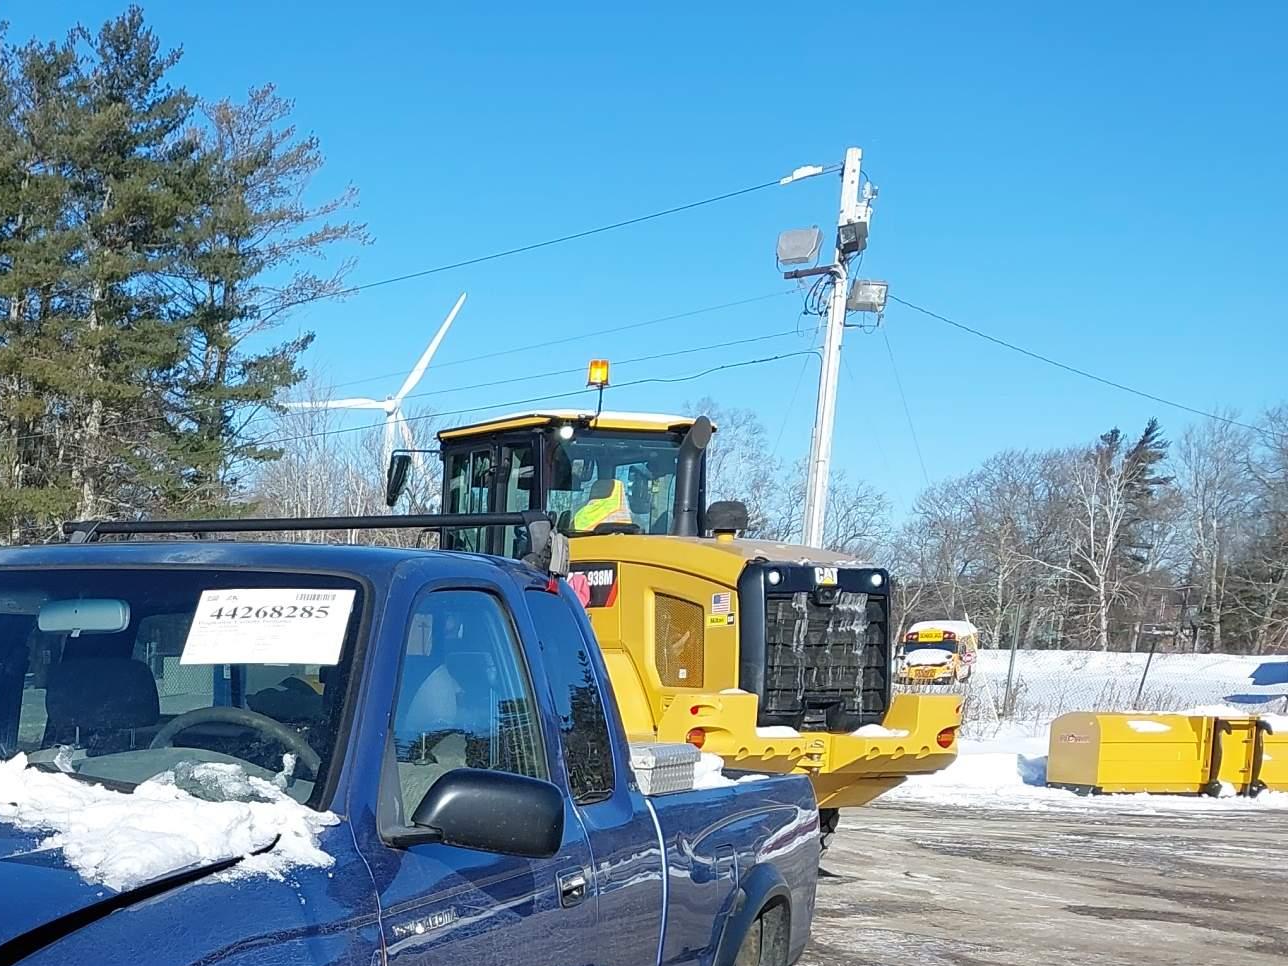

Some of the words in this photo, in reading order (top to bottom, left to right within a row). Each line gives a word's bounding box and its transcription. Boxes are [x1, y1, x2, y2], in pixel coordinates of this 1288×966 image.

[587, 569, 613, 586] 938M
[814, 567, 839, 585] CAT
[210, 605, 330, 620] 44268285
